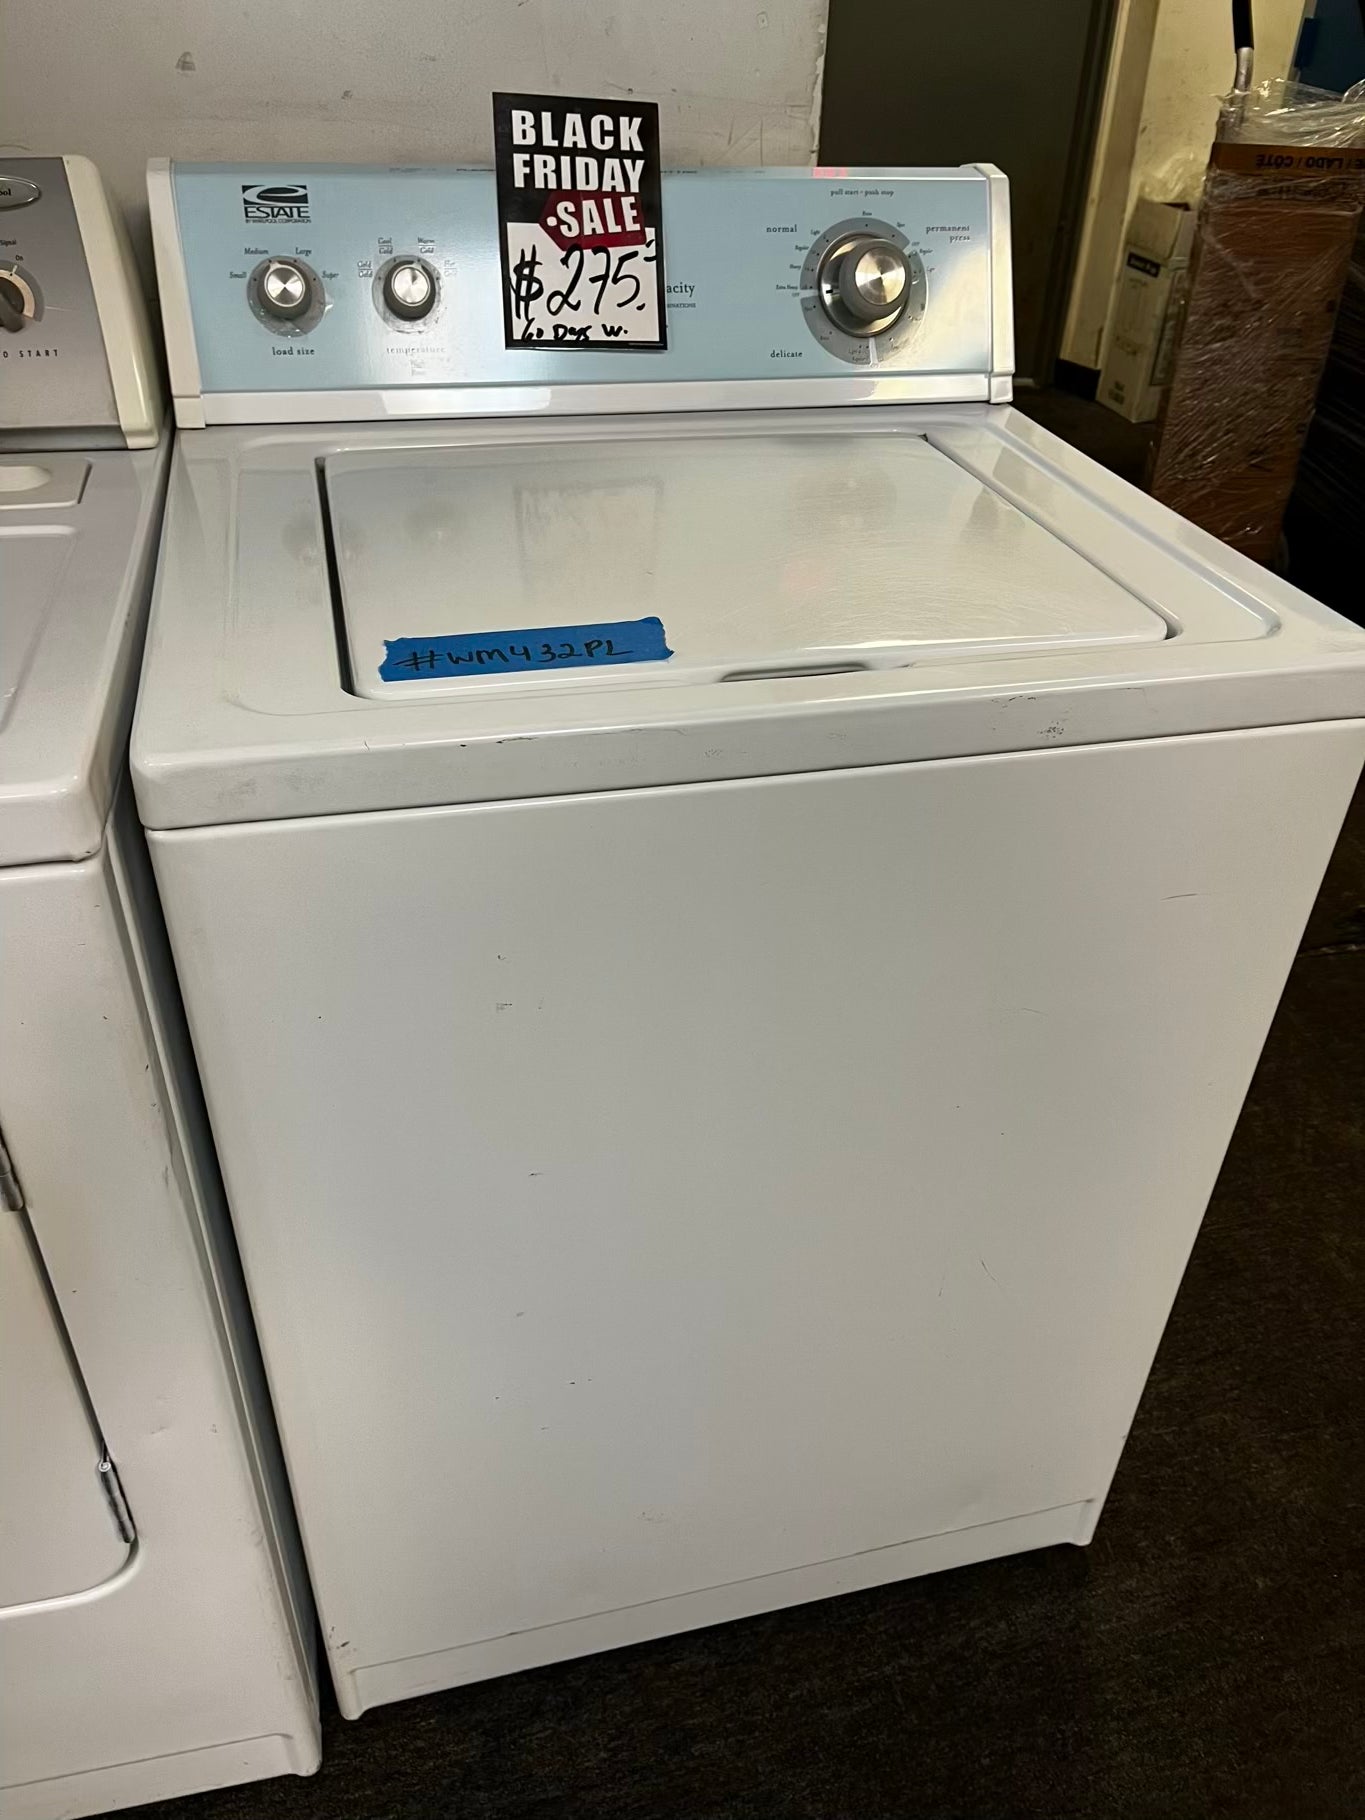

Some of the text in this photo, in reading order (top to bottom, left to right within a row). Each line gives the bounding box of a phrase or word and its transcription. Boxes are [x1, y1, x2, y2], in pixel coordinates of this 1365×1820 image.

[511, 109, 644, 152] BLACK
[513, 152, 645, 193] FRIDAY
[244, 205, 311, 219] ESTATE
[556, 196, 641, 238] SALE
[766, 224, 798, 233] normal
[926, 225, 970, 235] permanent
[950, 235, 970, 244] press
[244, 247, 269, 255] Medium
[15, 254, 24, 262] On
[19, 349, 59, 358] START
[272, 346, 315, 356] load size
[386, 345, 447, 356] temperature
[770, 349, 803, 359] delicate
